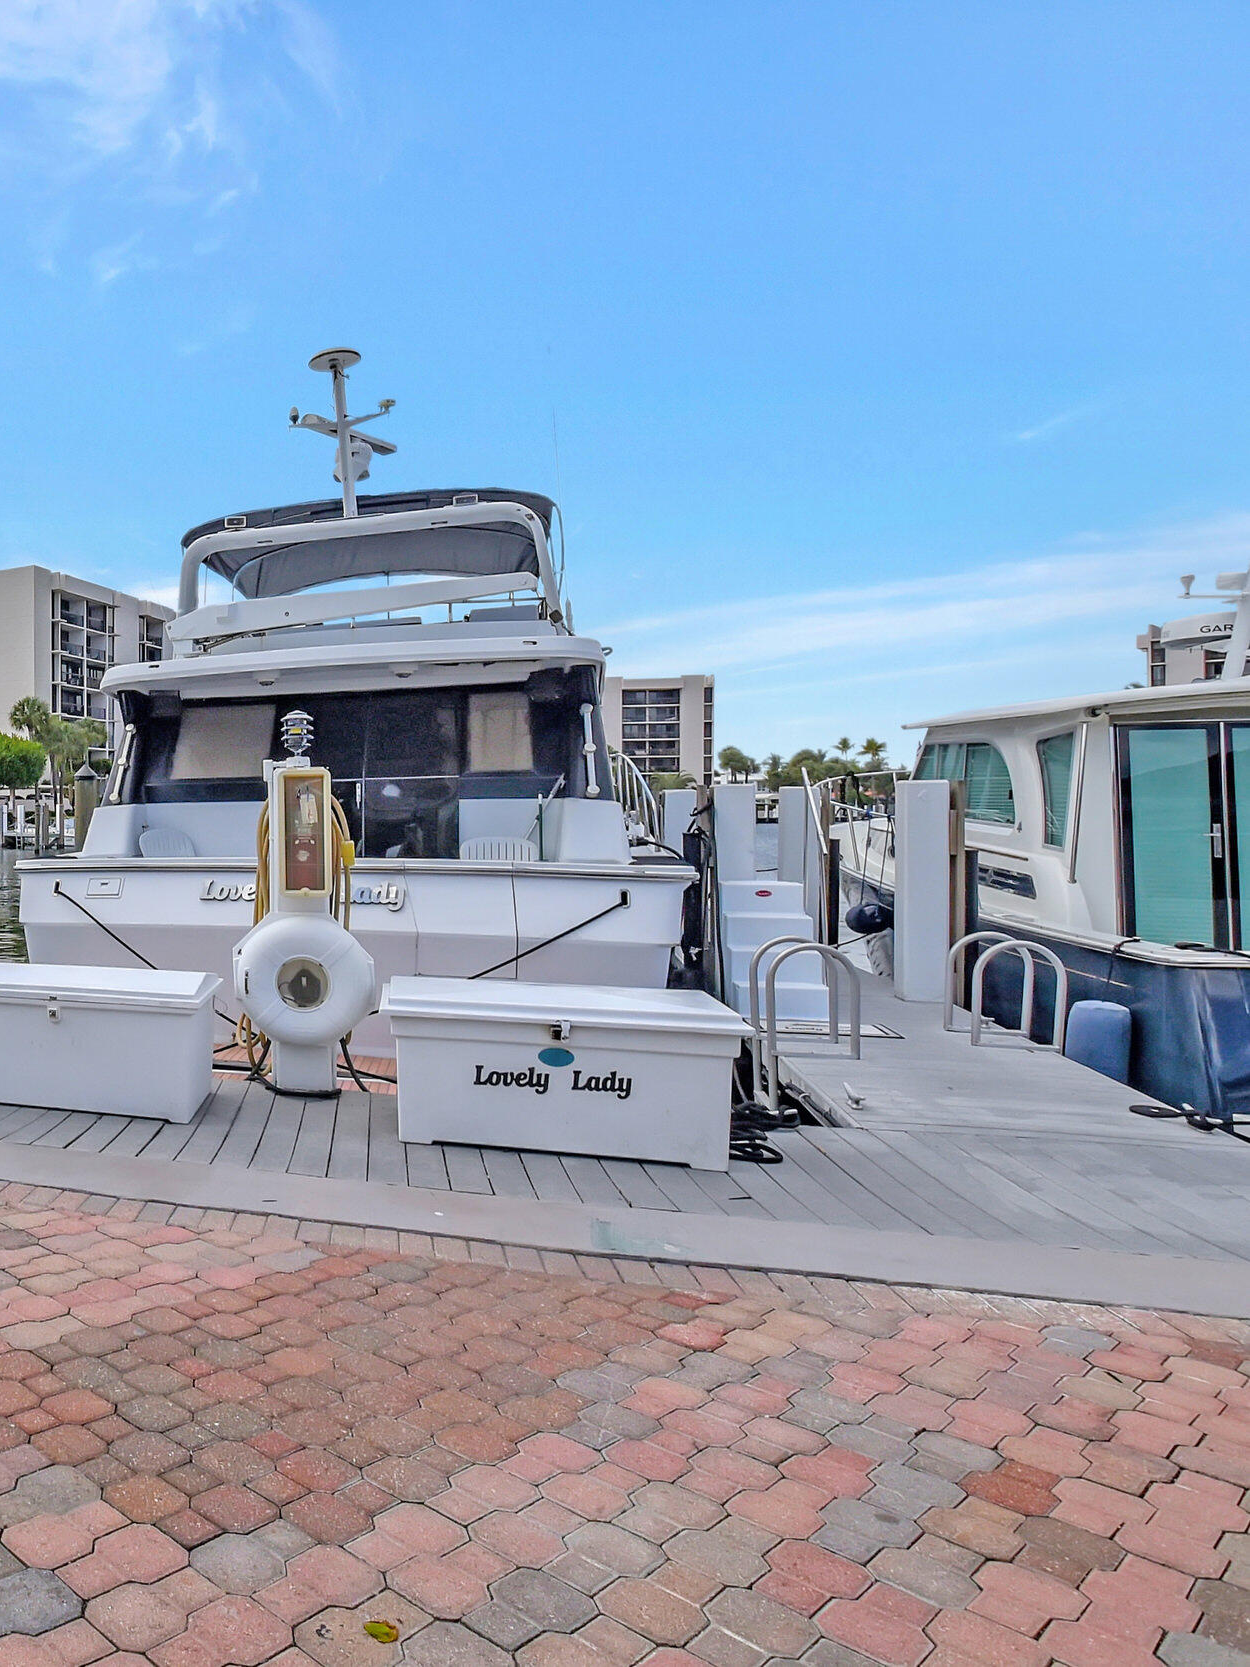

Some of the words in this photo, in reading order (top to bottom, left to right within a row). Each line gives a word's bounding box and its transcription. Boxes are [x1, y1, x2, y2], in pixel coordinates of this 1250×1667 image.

[1200, 624, 1234, 633] GAR
[200, 879, 256, 901] Love
[340, 880, 406, 912] ady
[474, 1065, 550, 1094] Lovely
[572, 1070, 632, 1099] Lady
